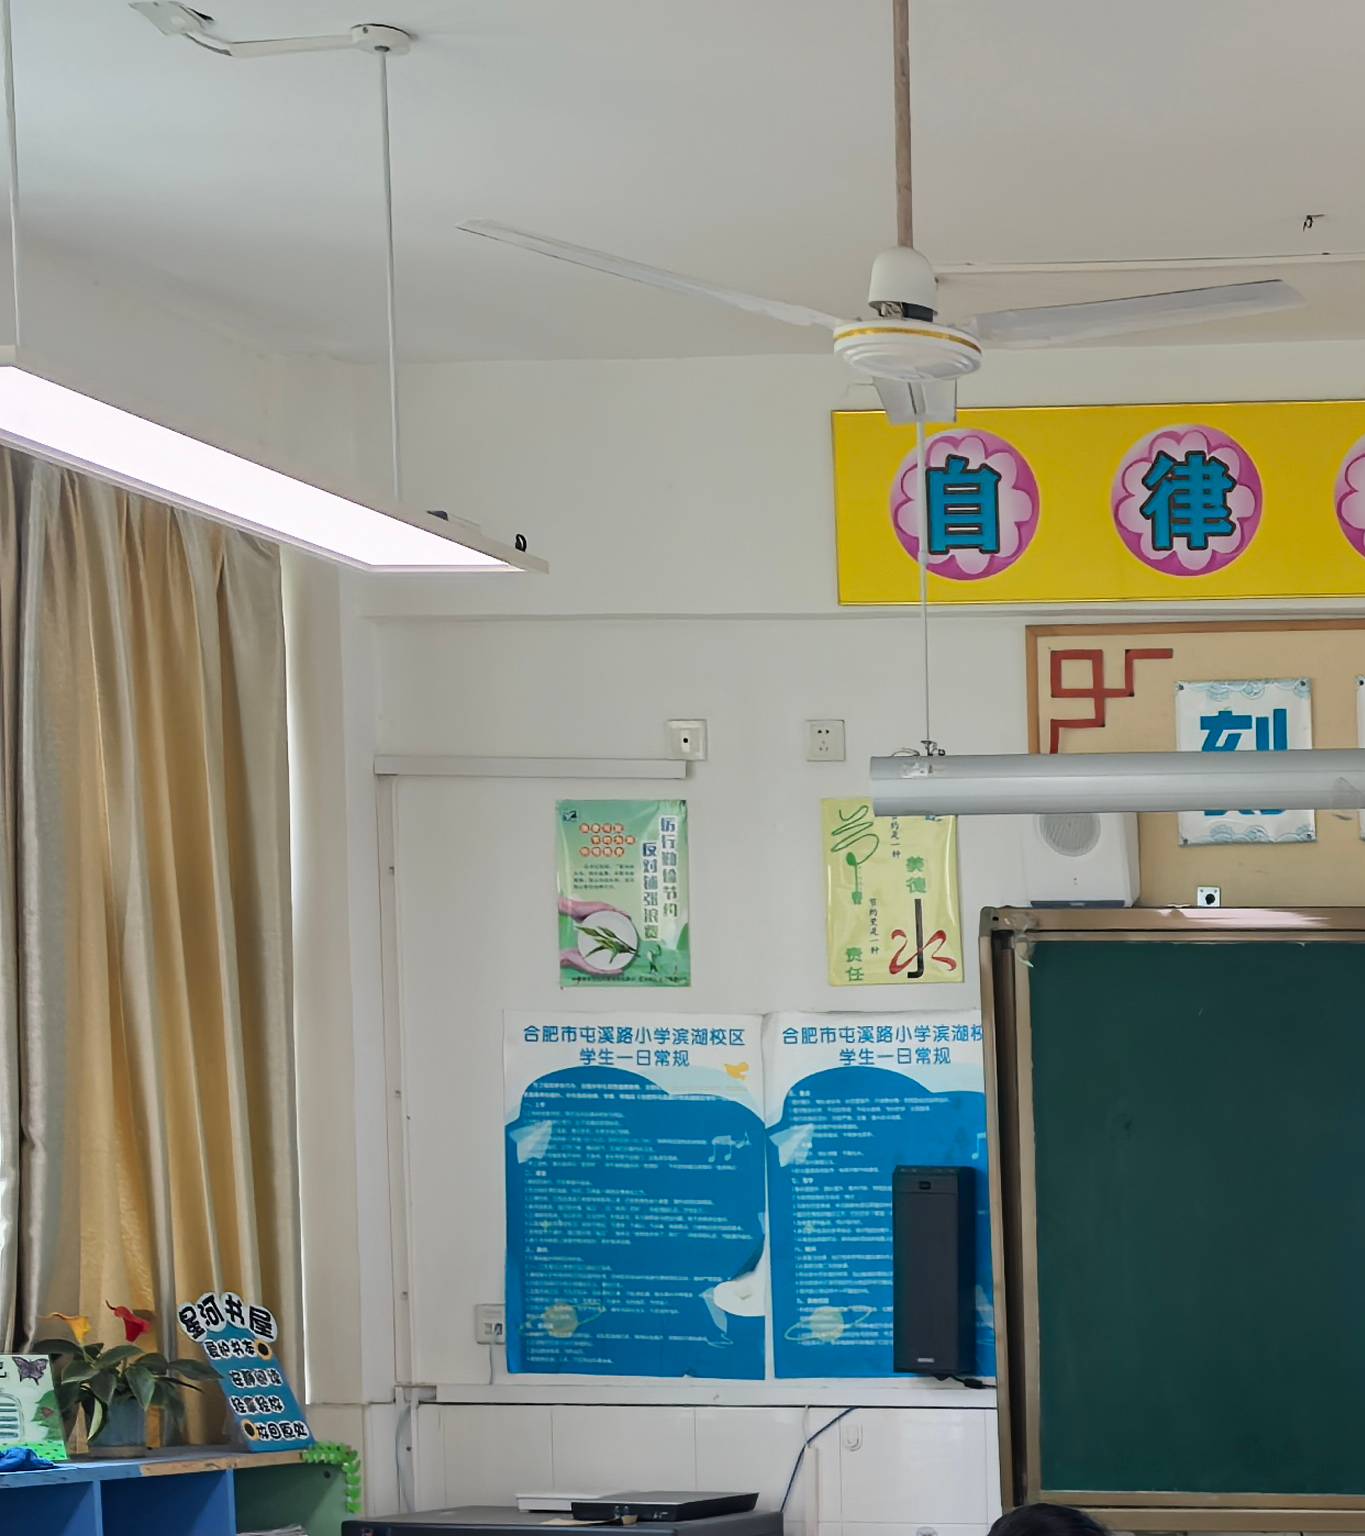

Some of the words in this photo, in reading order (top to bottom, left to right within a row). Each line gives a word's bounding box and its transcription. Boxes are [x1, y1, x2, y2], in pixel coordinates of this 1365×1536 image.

[890, 816, 901, 858] 约是一种
[523, 1025, 745, 1046] 合肥市屯溪路小学滨湖校区
[579, 1048, 690, 1067] 学生一日常规
[839, 1047, 951, 1066] 学生一日常规
[179, 1294, 274, 1340] 星河书屋
